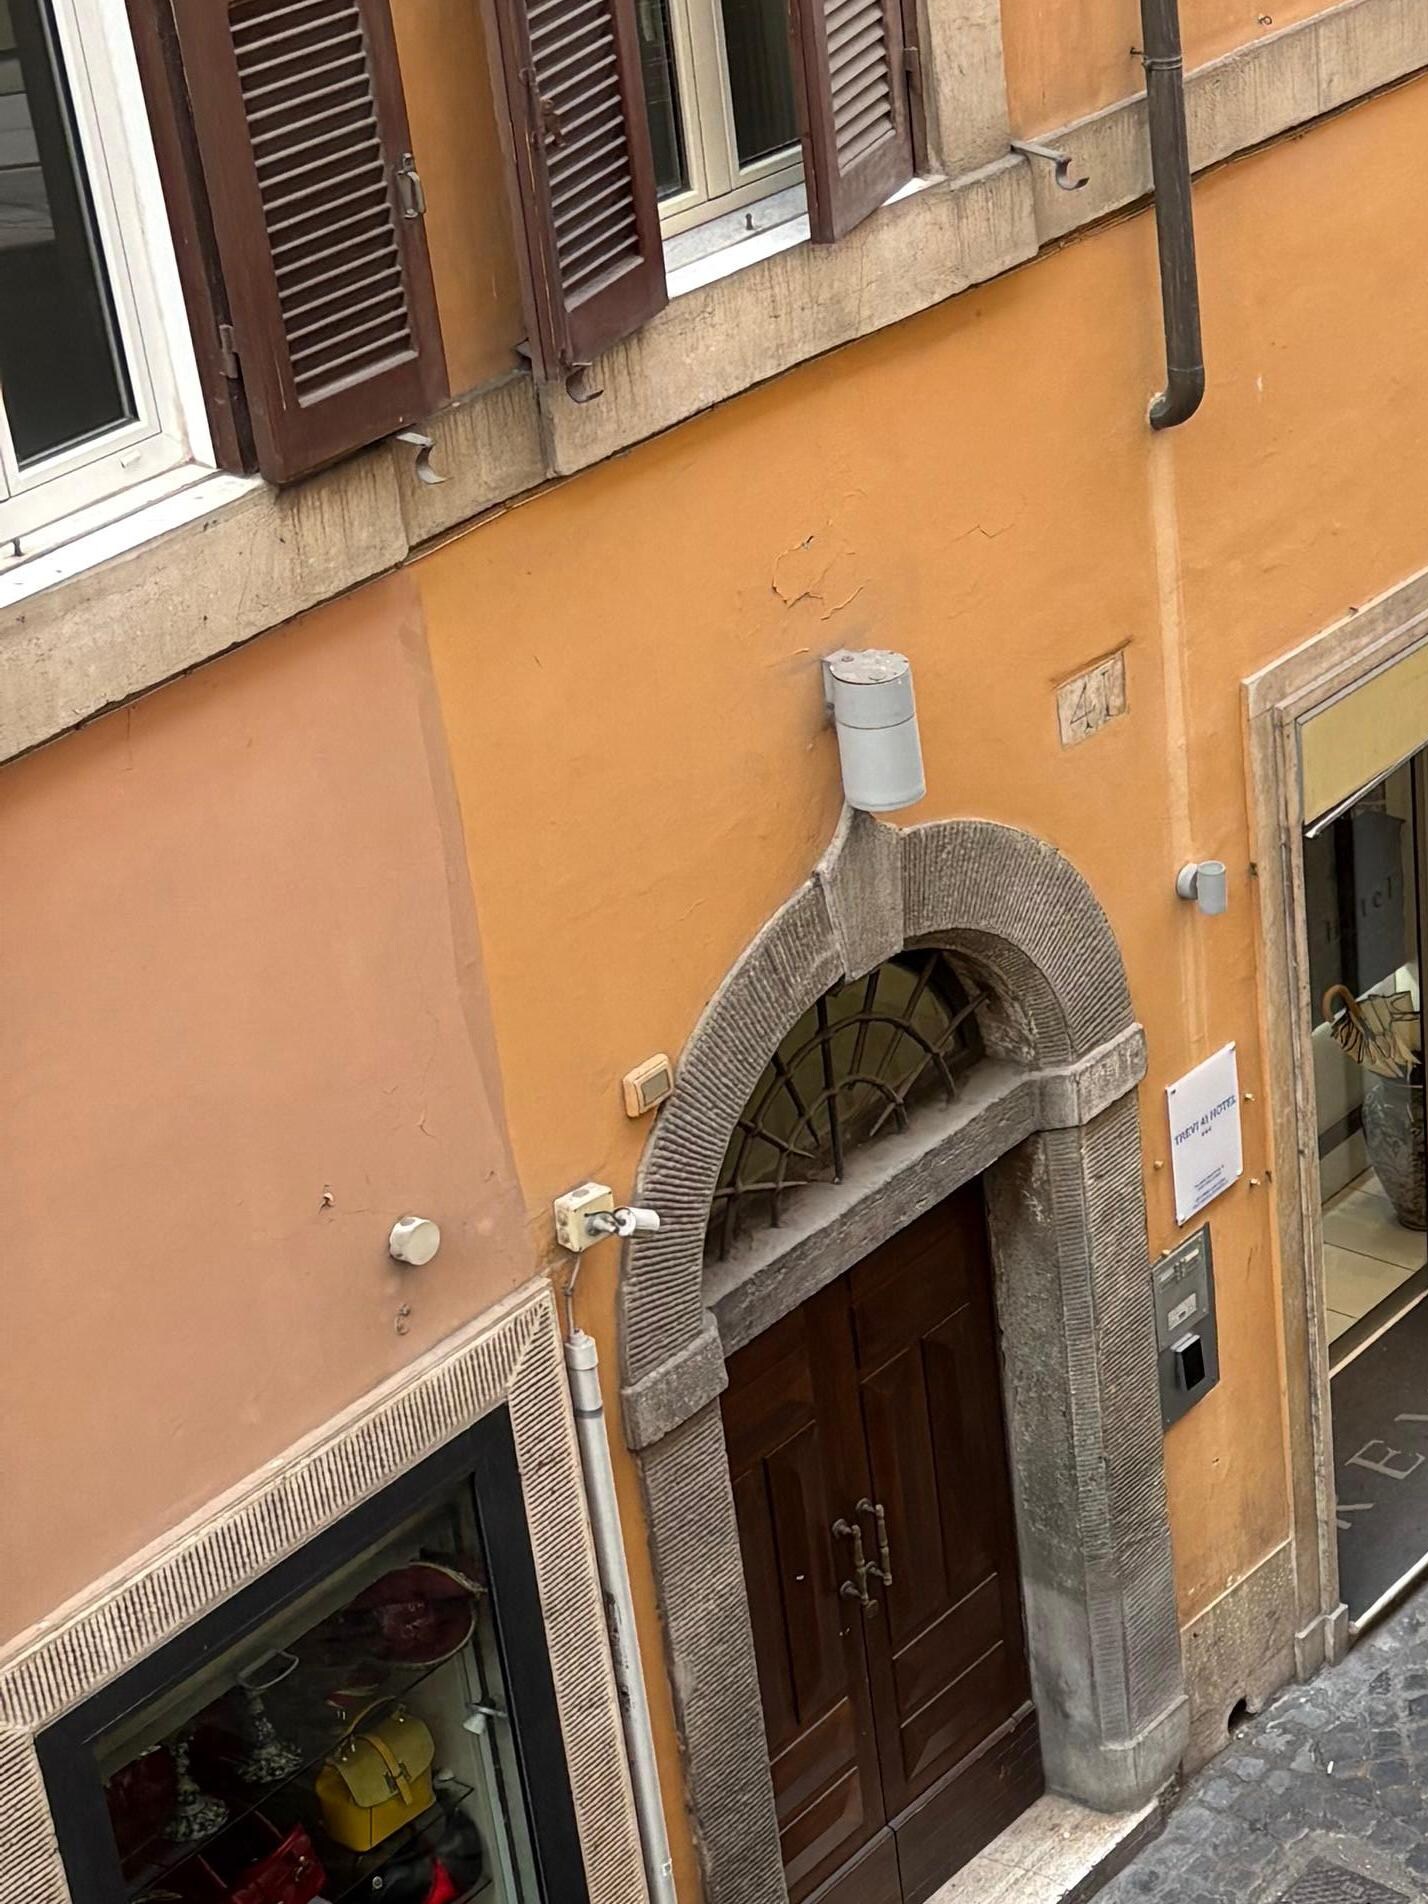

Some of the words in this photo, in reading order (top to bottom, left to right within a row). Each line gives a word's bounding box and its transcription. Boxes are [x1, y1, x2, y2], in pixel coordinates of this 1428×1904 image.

[1174, 1121, 1199, 1145] TREVI
[1200, 1114, 1208, 1125] 41
[1210, 1095, 1236, 1121] HOTEL
